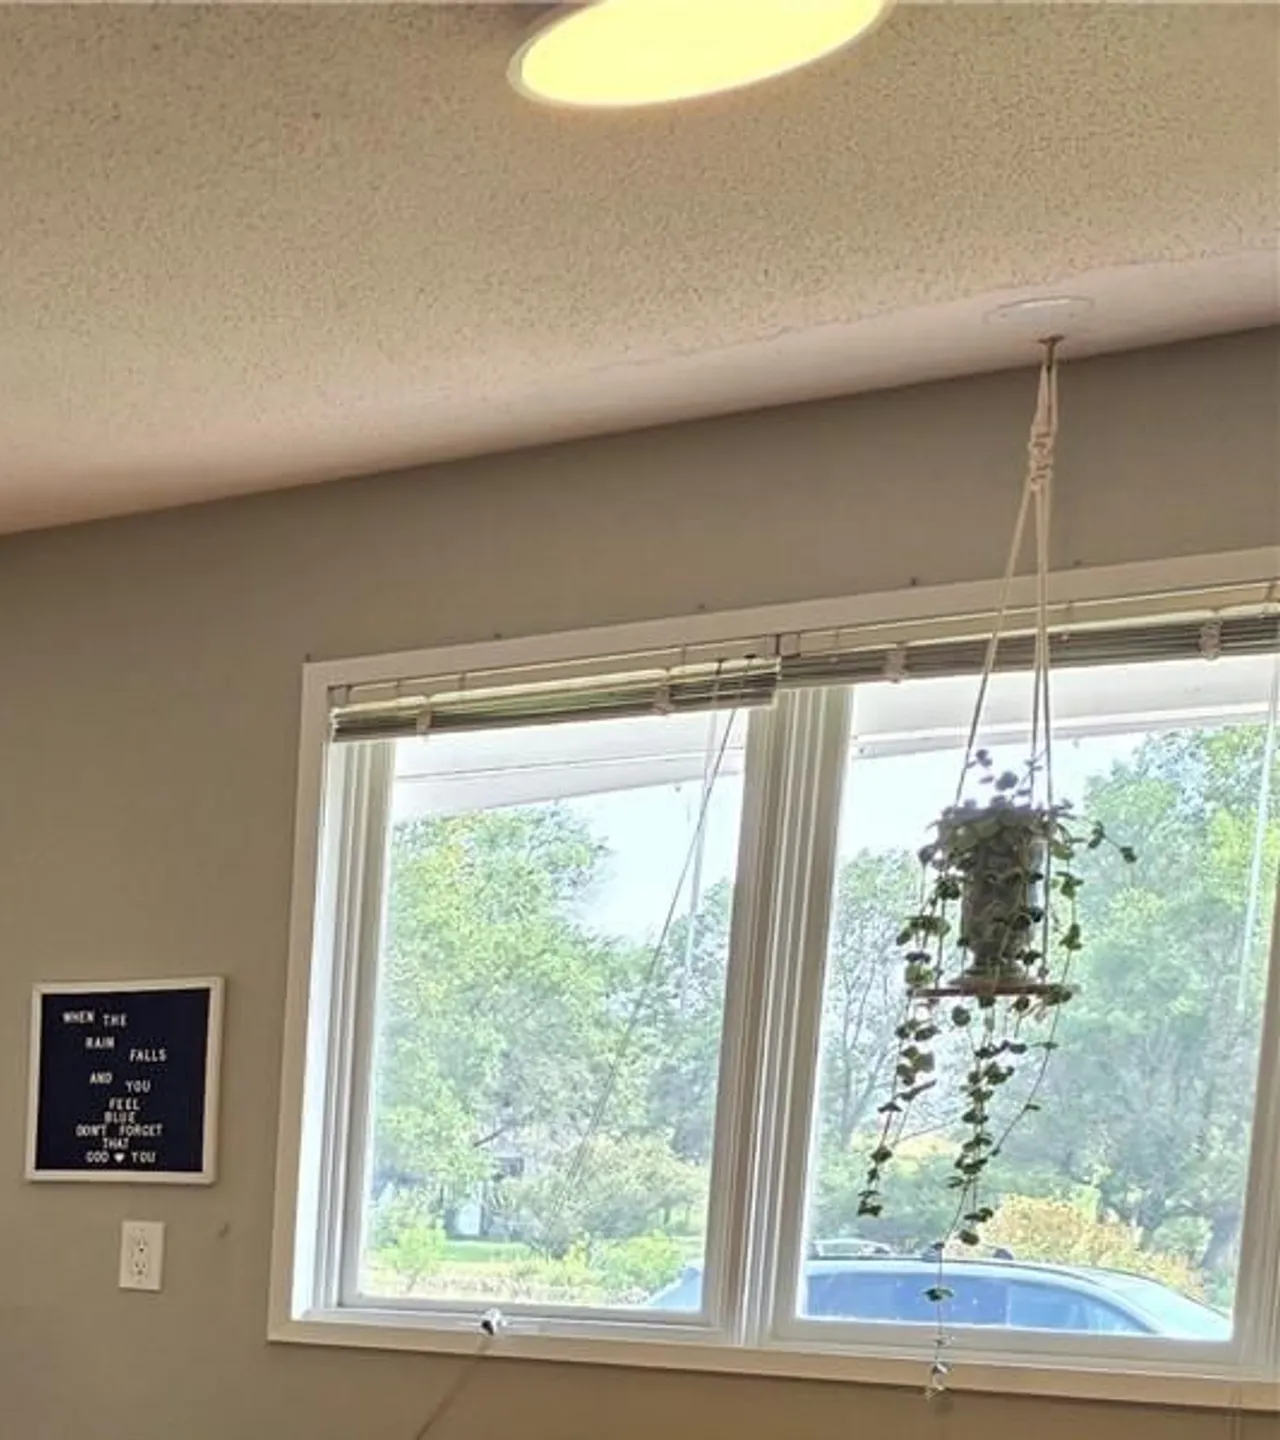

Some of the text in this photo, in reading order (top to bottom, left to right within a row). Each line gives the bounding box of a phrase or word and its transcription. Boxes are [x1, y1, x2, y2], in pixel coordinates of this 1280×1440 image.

[62, 1010, 128, 1027] WHEN THE
[85, 1036, 167, 1062] RAIN FALLS
[89, 1071, 151, 1093] AND YOU
[108, 1098, 140, 1110] FEEL
[104, 1111, 136, 1124] BLUE
[119, 1123, 163, 1136] FORGET
[102, 1137, 129, 1149] THAT
[85, 1151, 156, 1163] GOD YOU
